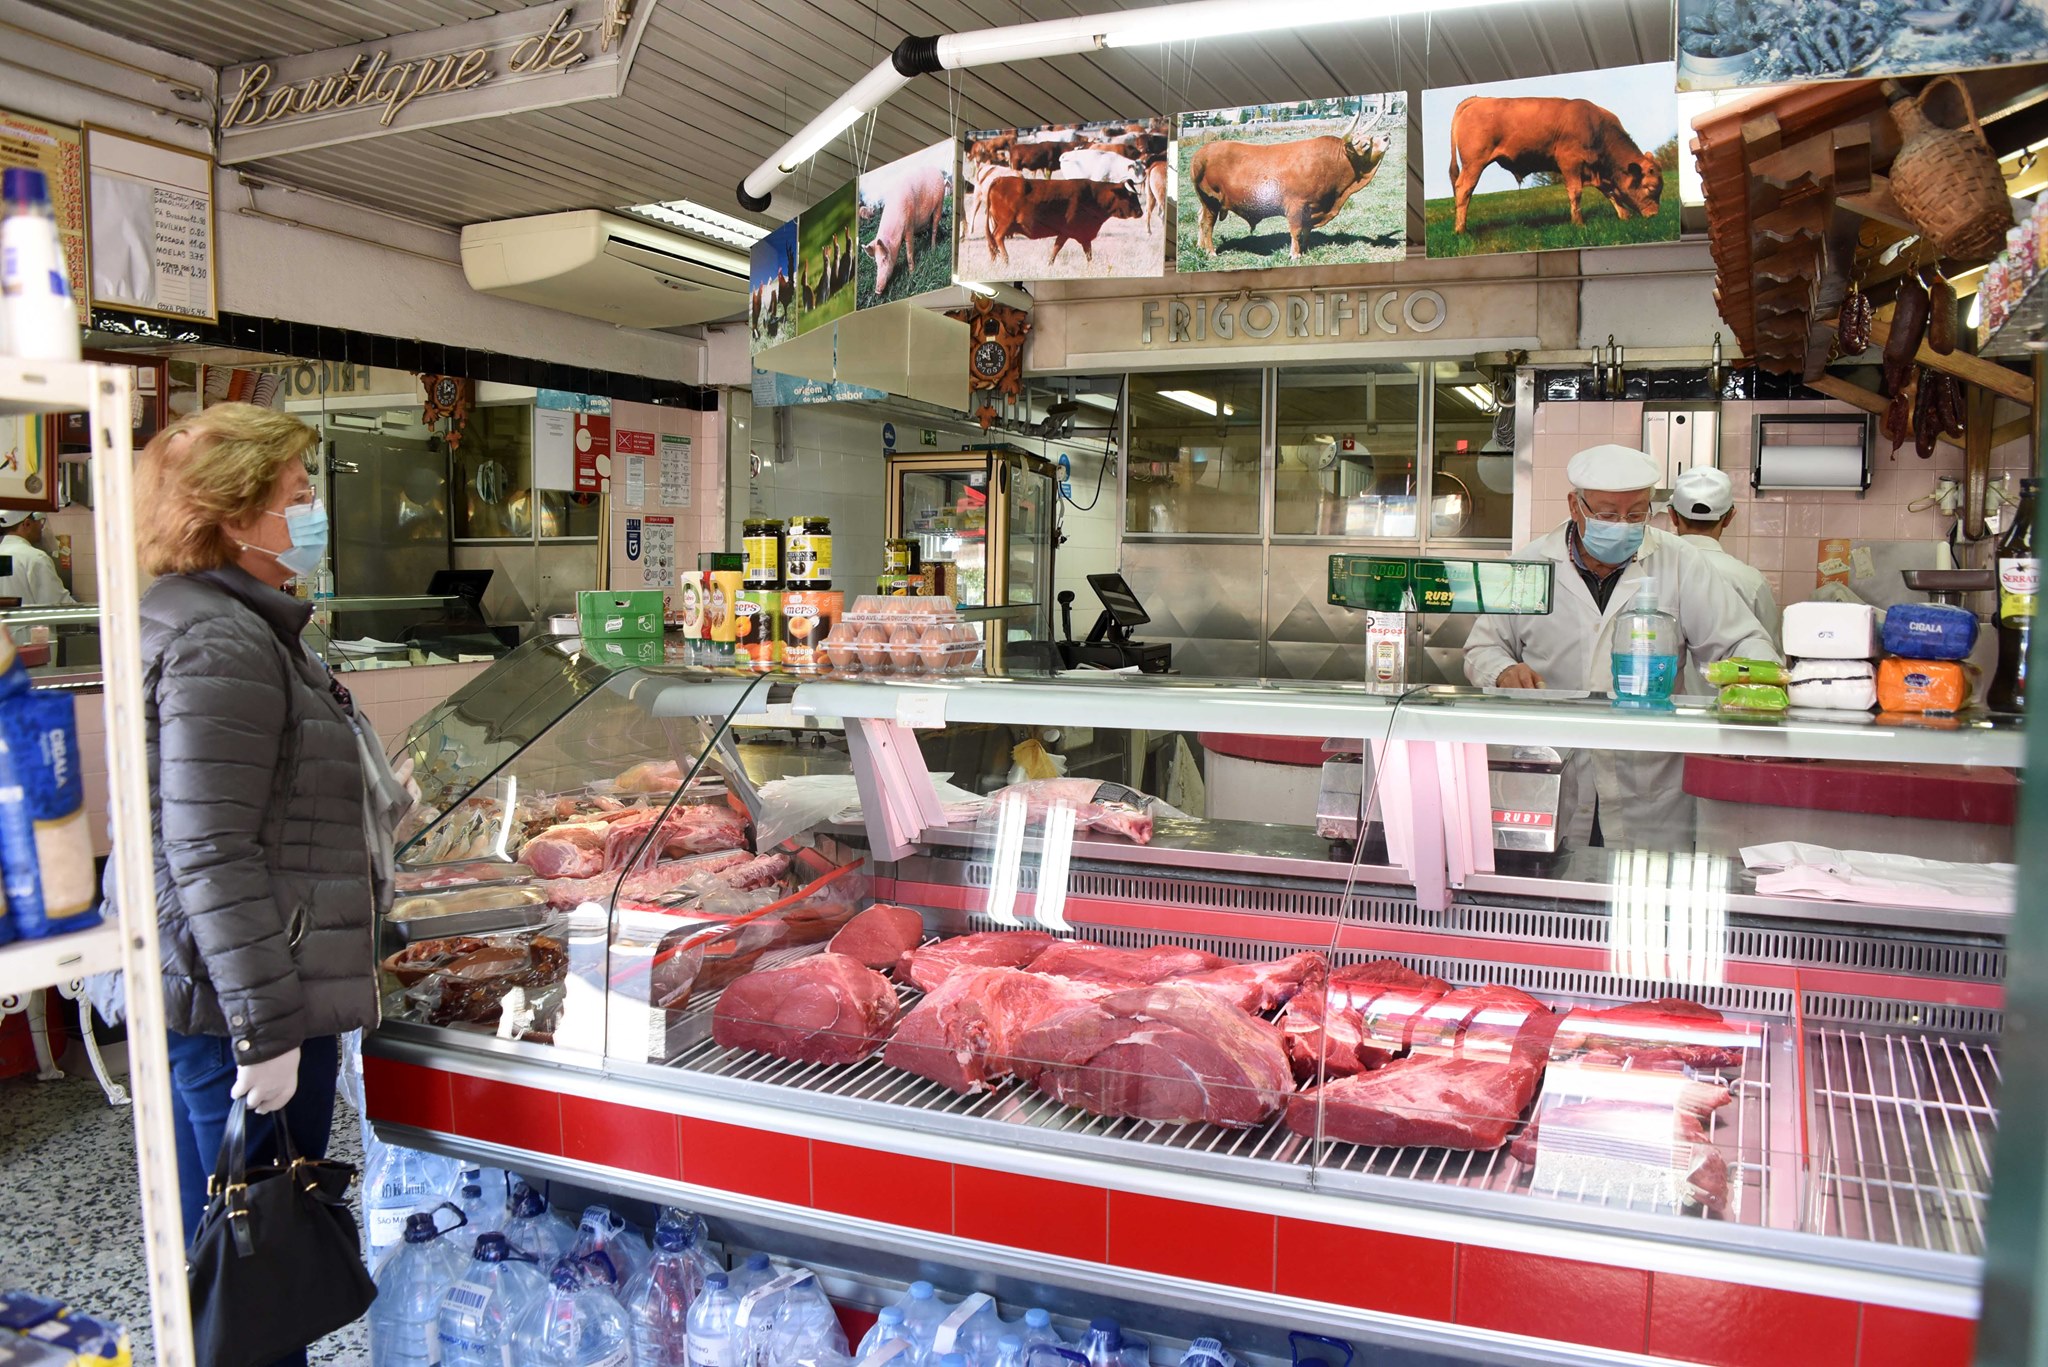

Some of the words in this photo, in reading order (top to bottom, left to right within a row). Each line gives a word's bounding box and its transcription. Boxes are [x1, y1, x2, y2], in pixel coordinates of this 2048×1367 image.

[508, 7, 586, 74] de
[156, 247, 185, 258] MOELAS
[1141, 289, 1447, 344] FRIGORIFICO
[793, 385, 823, 396] origem
[835, 391, 863, 401] sabor
[812, 395, 828, 403] todo
[1425, 591, 1455, 601] RUBY
[1909, 622, 1943, 633] CIGALA
[1503, 812, 1541, 824] RUBY
